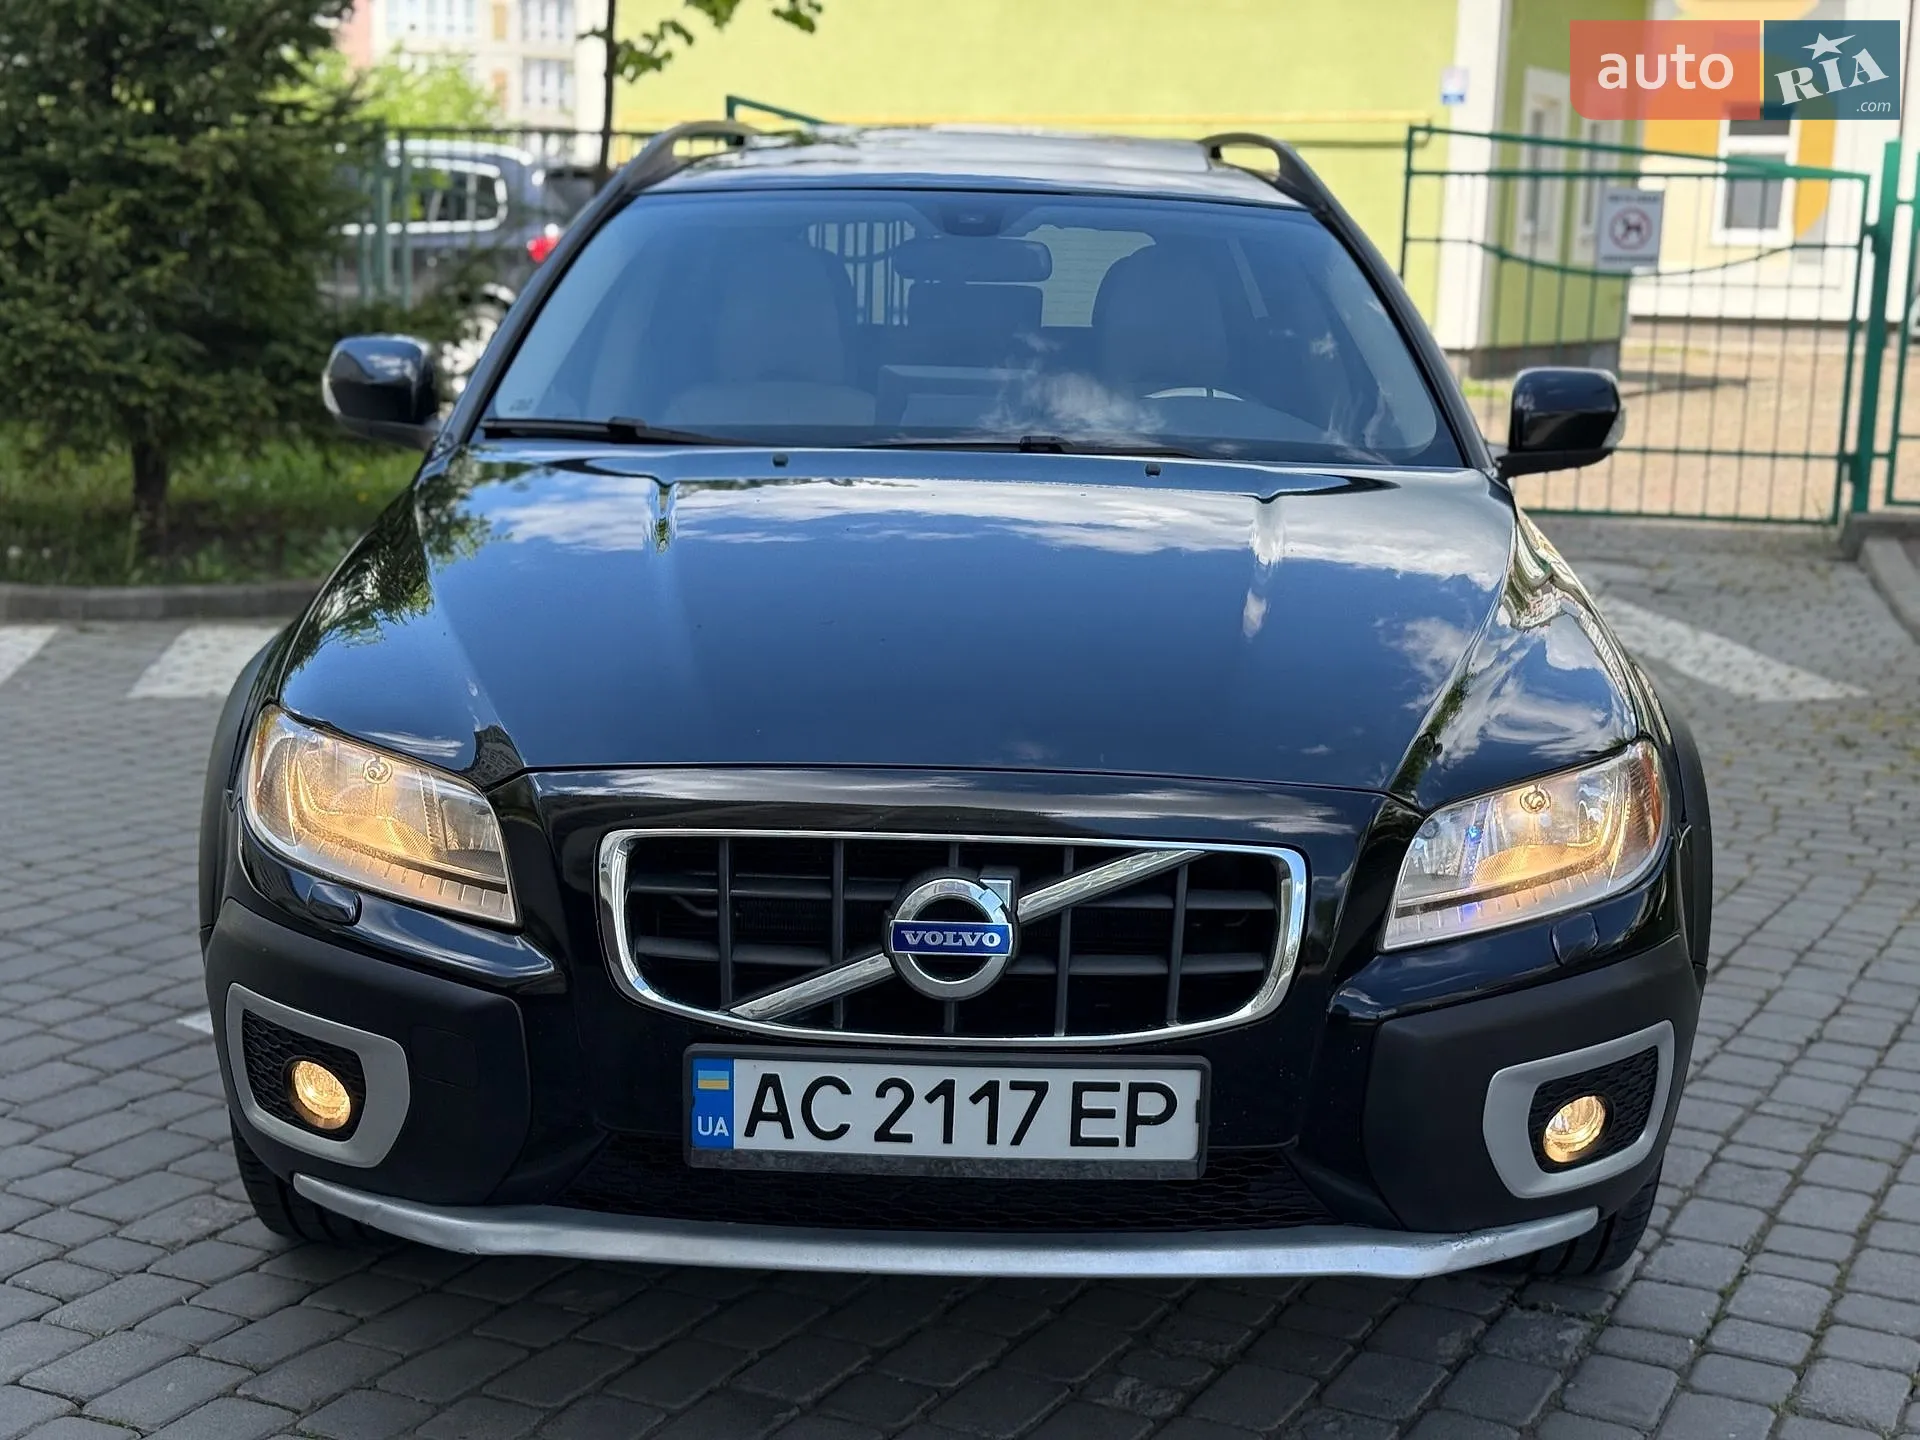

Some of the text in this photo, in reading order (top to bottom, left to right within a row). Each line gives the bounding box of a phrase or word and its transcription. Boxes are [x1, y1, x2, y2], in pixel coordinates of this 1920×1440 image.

[901, 930, 1001, 947] VOLVO
[744, 1073, 1178, 1148] AC 2117 EP
[697, 1115, 729, 1137] UA
